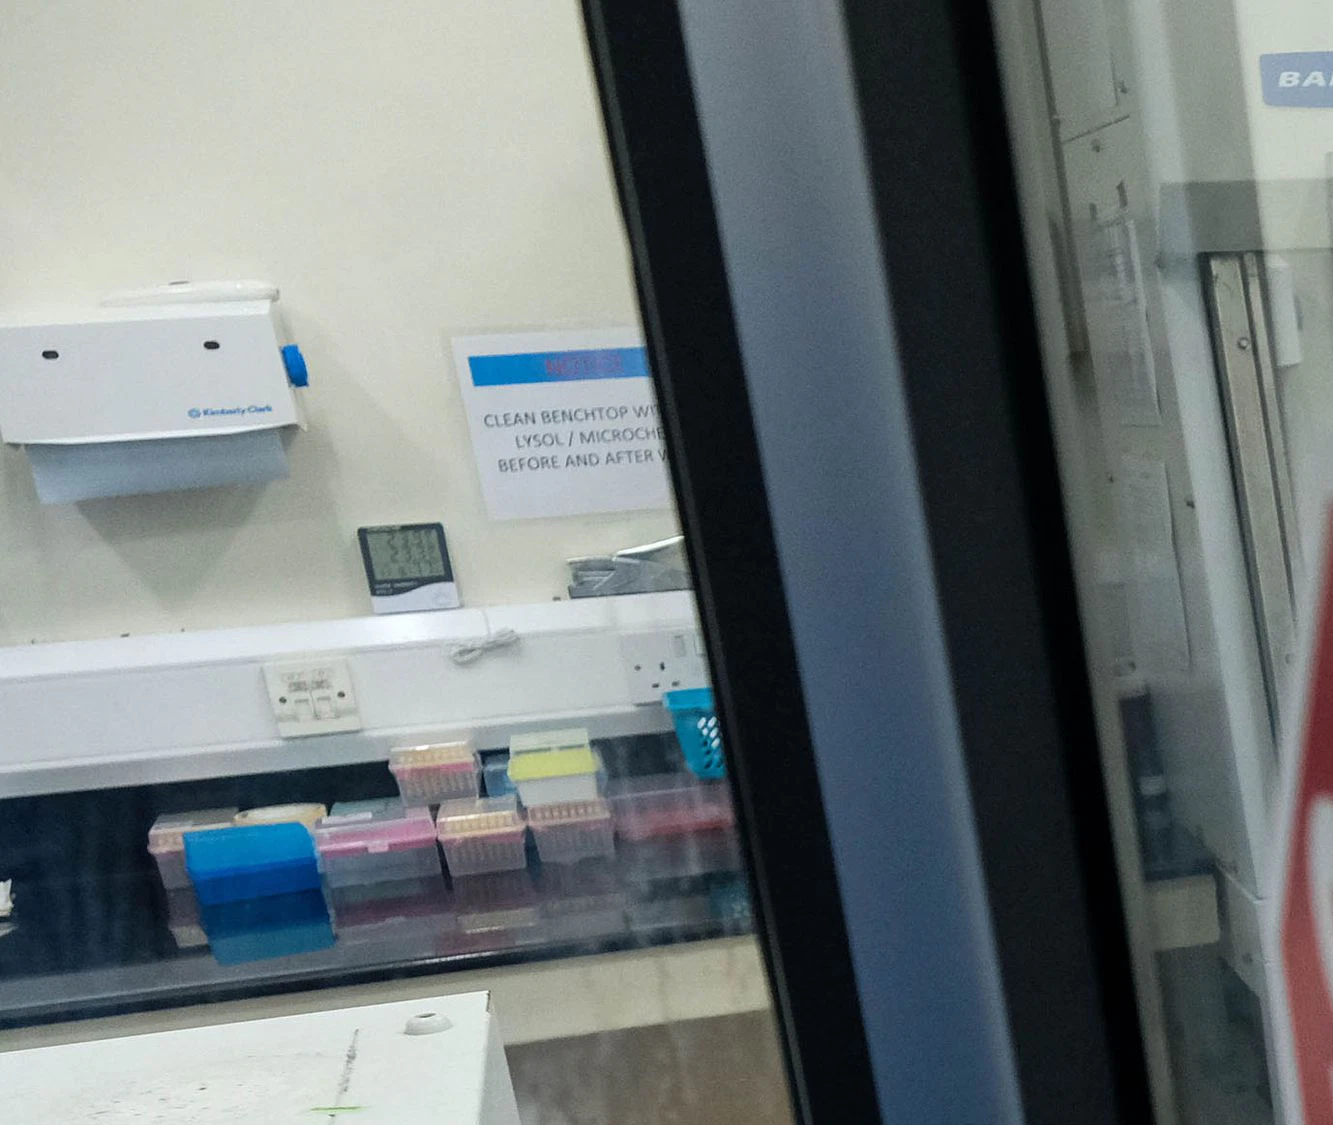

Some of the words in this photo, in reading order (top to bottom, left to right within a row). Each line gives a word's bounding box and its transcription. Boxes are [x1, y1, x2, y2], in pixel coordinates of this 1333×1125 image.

[483, 411, 537, 428] CLEAN
[541, 406, 628, 424] BENCHTOP
[515, 433, 564, 449] LYSOL
[498, 455, 560, 473] BEFORE
[565, 452, 600, 468] AND
[605, 449, 654, 466] AFTER
